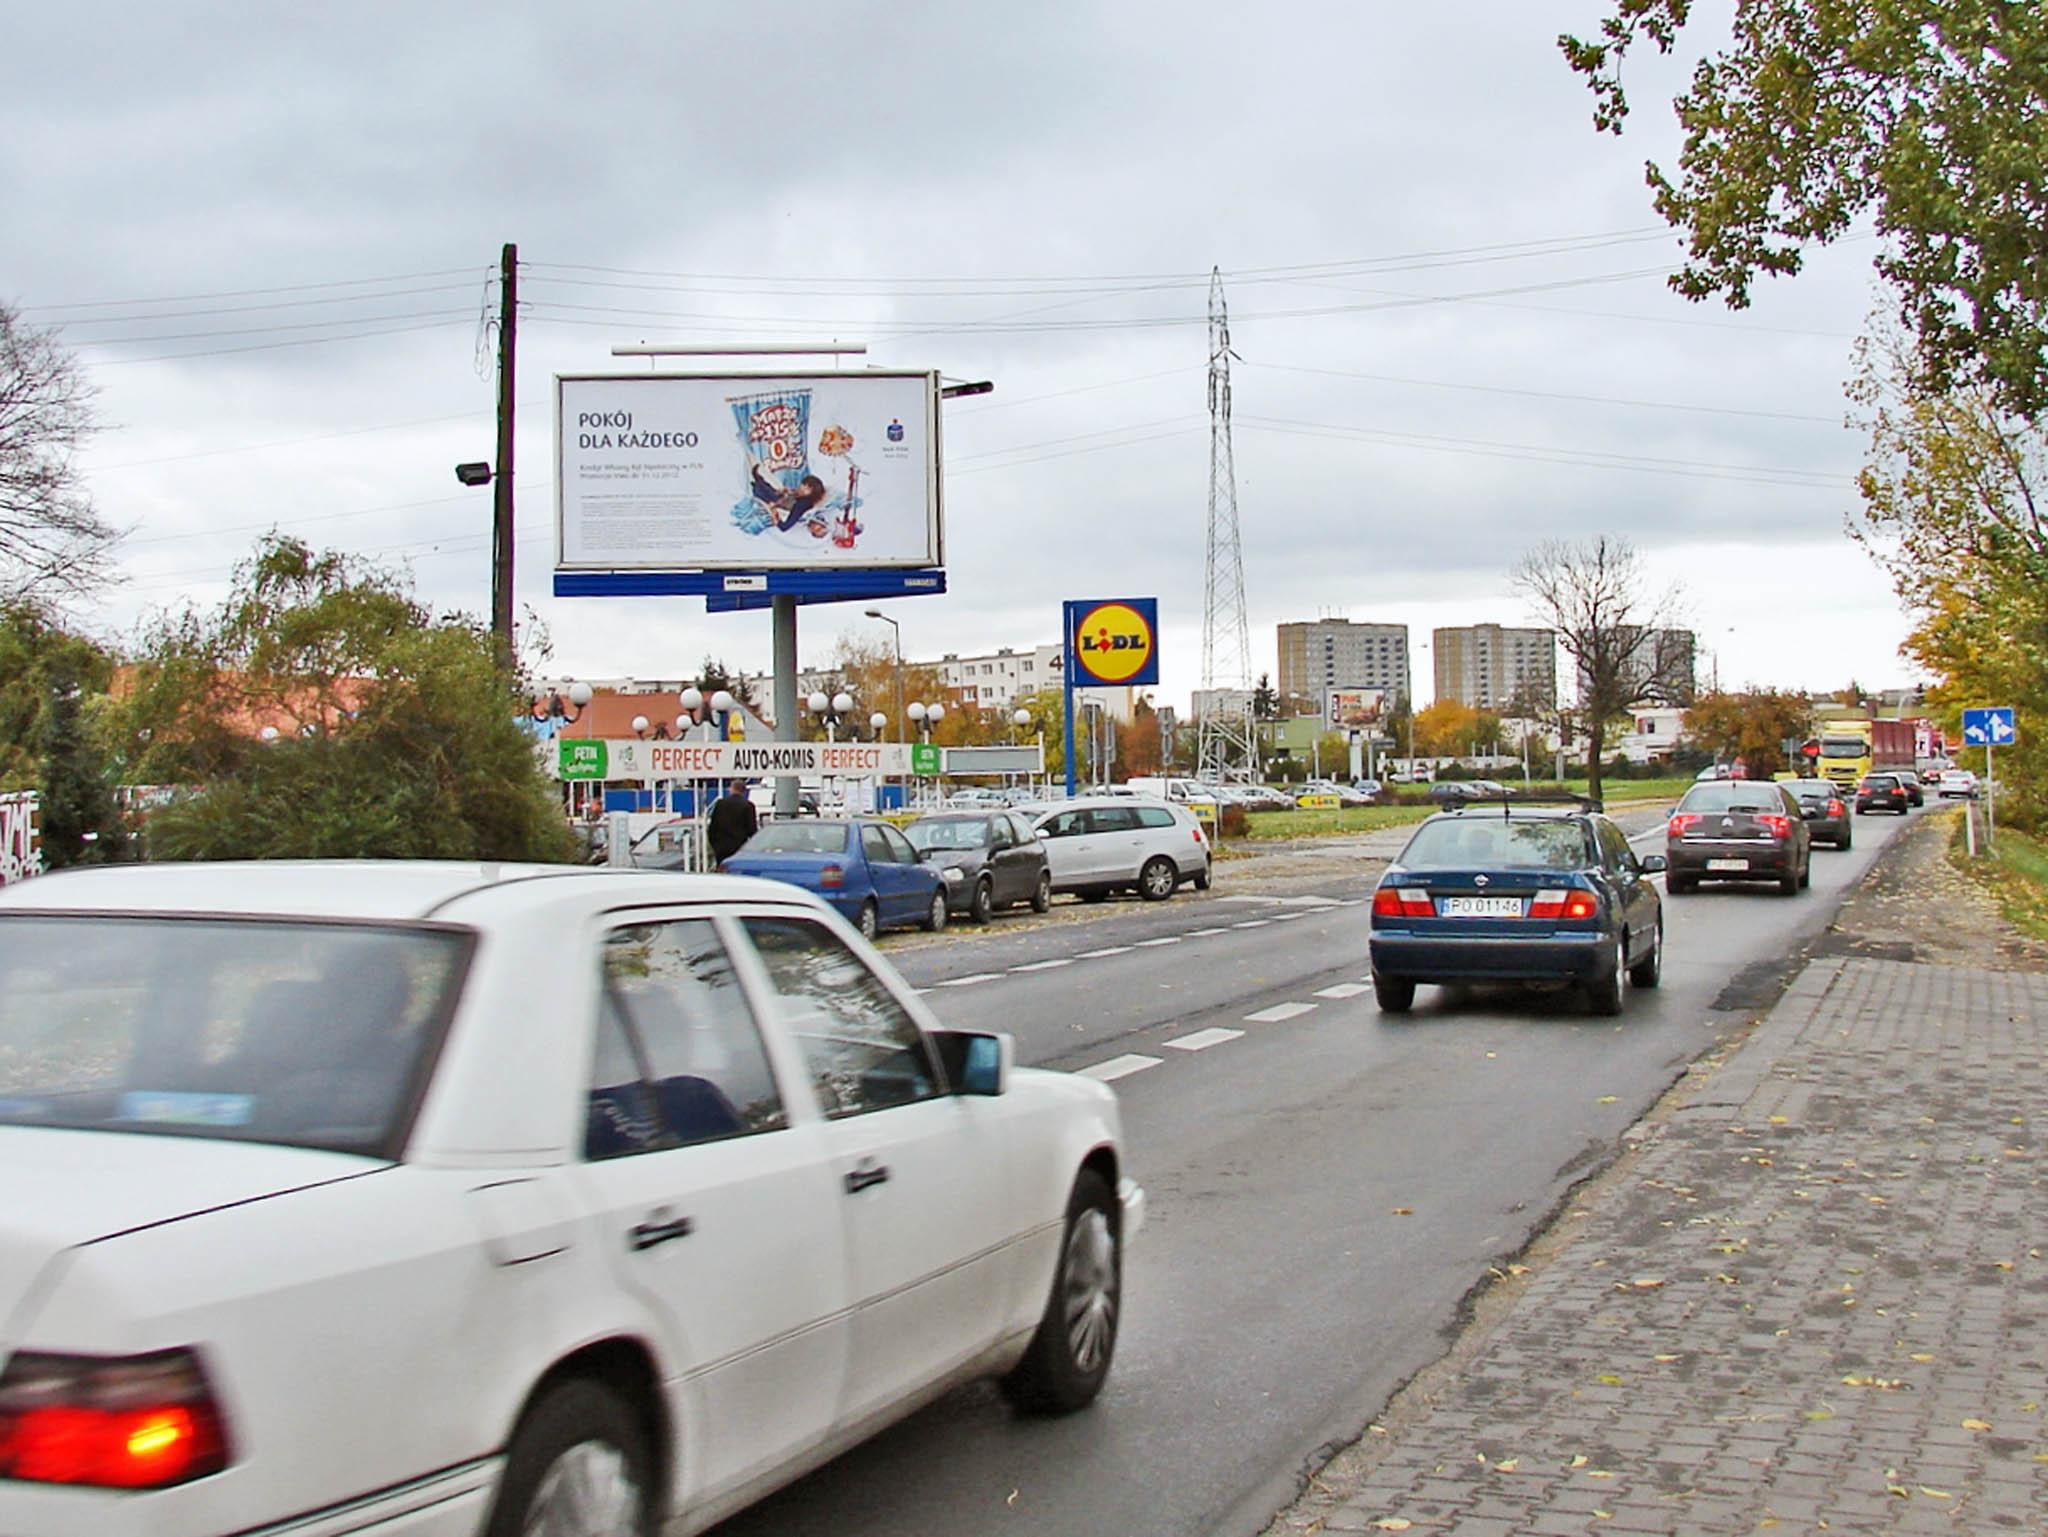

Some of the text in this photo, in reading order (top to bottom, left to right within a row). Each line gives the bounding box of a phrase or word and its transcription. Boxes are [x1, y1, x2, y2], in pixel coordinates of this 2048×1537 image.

[579, 409, 632, 430] POKÓJ
[579, 430, 699, 449] DLA KAŻDEGO
[1082, 628, 1145, 654] LIDL
[1049, 655, 1063, 671] 4
[651, 748, 722, 771] PERFECT
[733, 748, 815, 770] AUTO-KOMIS
[822, 748, 881, 769] PERFECT
[1452, 899, 1519, 912] PO 01146
